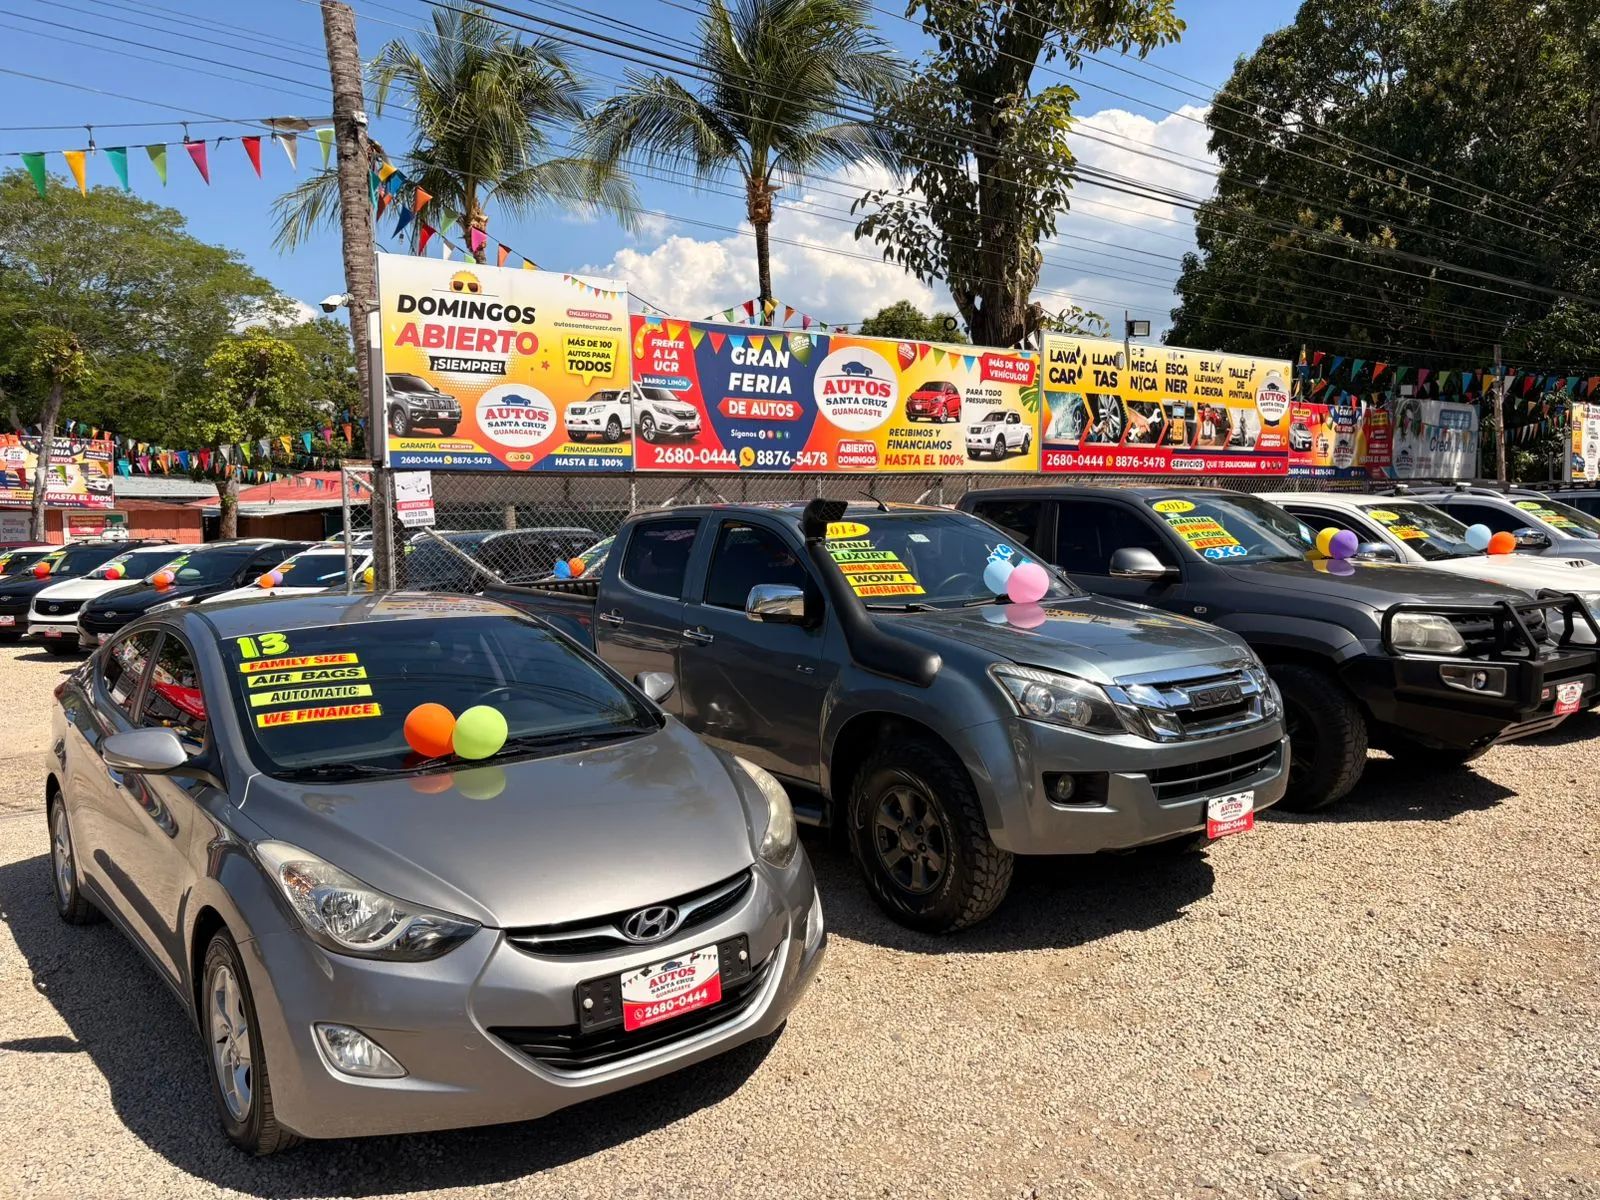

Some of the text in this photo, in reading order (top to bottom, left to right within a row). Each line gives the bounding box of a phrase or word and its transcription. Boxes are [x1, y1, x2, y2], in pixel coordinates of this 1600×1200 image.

[397, 294, 536, 324] DOMINGOS
[554, 322, 622, 332] autossantacruzcr.com
[395, 322, 539, 356] ABIERTO
[568, 337, 585, 346] MÁS
[651, 339, 684, 349] FRENTE
[653, 350, 678, 360] A LA
[731, 348, 790, 369] GRAN
[1050, 350, 1077, 364] LAVA
[1092, 353, 1116, 366] LLAN
[433, 357, 503, 373] ¡SIEMPRE!
[568, 360, 612, 372] TODOS
[654, 362, 679, 372] UCR
[1016, 362, 1030, 372] 100
[1131, 360, 1158, 373] MECÁ
[1166, 363, 1188, 376] ESCA
[1200, 362, 1209, 371] SE
[990, 370, 1028, 381] VEHÍCULOS!
[1049, 368, 1077, 385] CAR
[1093, 371, 1118, 388] TAS
[1194, 374, 1224, 384] LLEVAMOS
[644, 377, 687, 387] BARRIO LIMÓN
[728, 372, 792, 395] FERIA
[1165, 378, 1187, 393] NER
[1237, 381, 1245, 389] DE
[823, 380, 891, 398] AUTOS
[1194, 386, 1223, 397] A DEKRA
[1229, 390, 1253, 400] PINTURA
[1260, 392, 1286, 402] AUTOS
[826, 397, 888, 408] SANTA CRUZ
[728, 401, 794, 417] DE AUTOS
[832, 408, 882, 417] GUANACASTE
[485, 408, 550, 422] AUTOS
[488, 420, 546, 430] SANTA CRUZ
[494, 428, 542, 437] GUANACASTE
[731, 429, 757, 438] Síganos
[889, 429, 932, 437] RECIBIMOS
[564, 446, 623, 454] FINANCIAMIENTO
[840, 443, 874, 453] ABIERTO
[887, 440, 952, 450] FINANCIAMOS
[555, 458, 586, 466] HASTA
[602, 458, 623, 467] 100%
[655, 448, 827, 466] 2680-0444 8876-5478
[838, 455, 876, 465] DOMINGOS
[884, 455, 964, 467] HASTA EL 100%
[1046, 454, 1165, 468] 2680-0444 8876-5478
[1172, 460, 1203, 468] SERVICIOS
[1161, 502, 1188, 511] 2012
[1170, 517, 1214, 525] MANUAL
[827, 524, 857, 536] 014
[1196, 538, 1234, 546] DIESEL
[834, 552, 887, 560] LUXURY
[853, 574, 894, 582] WOW
[859, 586, 917, 595] WARRANTY
[237, 632, 289, 659] 13
[250, 654, 347, 671] FAMILY SIZE
[253, 668, 359, 686] AIR BAGS
[271, 686, 359, 702] AUTOMATIC
[264, 704, 374, 724] WE FINANCE
[1221, 802, 1242, 812] AUTOS
[649, 966, 696, 989] AUTOS
[651, 977, 694, 994] SANTA CRUZ
[656, 984, 691, 998] GUANACASTE
[645, 989, 708, 1018] 2680-0444
